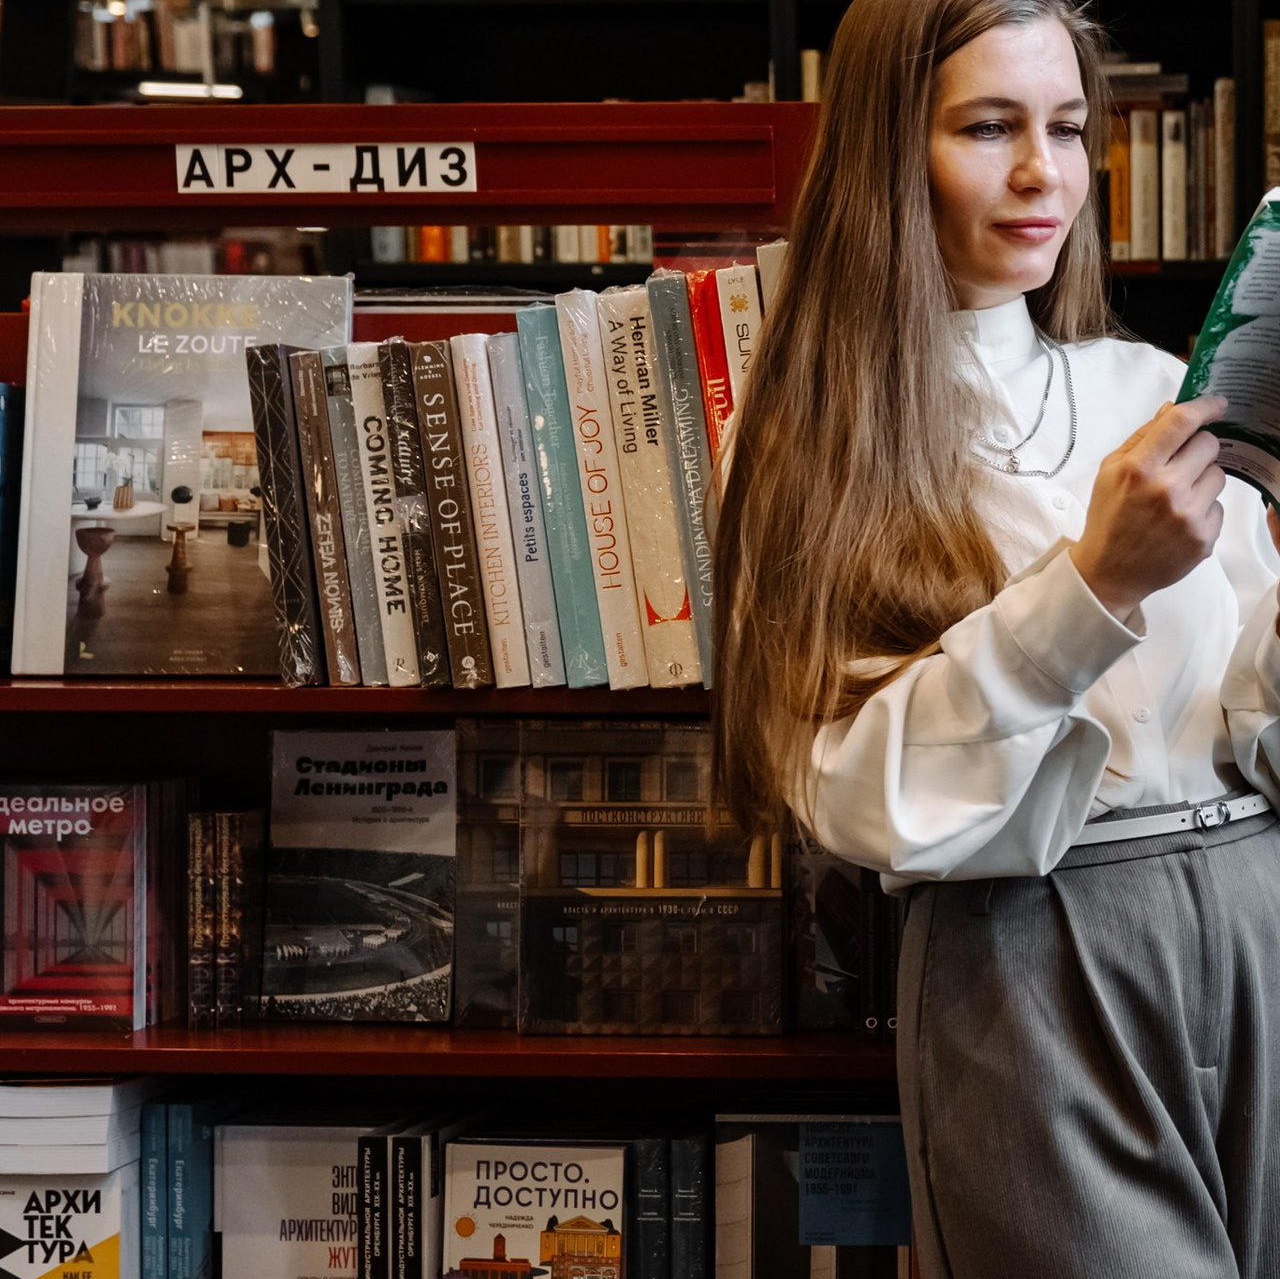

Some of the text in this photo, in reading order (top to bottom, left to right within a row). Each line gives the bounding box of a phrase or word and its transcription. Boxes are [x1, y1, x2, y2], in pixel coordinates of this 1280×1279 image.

[182, 146, 470, 192] АРХ-ДИЗ
[111, 301, 260, 329] KNOKKE
[138, 334, 258, 354] LE ZOUTE
[536, 334, 551, 388] Fashion
[608, 320, 638, 454] A Way of Living
[629, 315, 660, 447] Herman Miller
[576, 404, 623, 591] HOUSE OF JOY
[673, 387, 713, 607] SCANDINAVIA DREAMING
[363, 415, 407, 616] COMING HOME
[422, 392, 475, 638] SENSE OF PLACE
[519, 471, 539, 563] Petits espaces
[470, 441, 511, 627] KITCHEN INTERIORS
[314, 512, 343, 632] SIMÓN VÉLEZ
[501, 637, 511, 675] gestalten
[541, 629, 551, 669] gestalten
[617, 631, 628, 669] gestalten
[295, 756, 427, 776] Стадионы
[294, 778, 448, 801] Ленинграда
[581, 809, 722, 823] ПОСТКОНСТРУКТИВИ
[8, 818, 92, 843] метро
[716, 904, 740, 915] СССР
[804, 1137, 875, 1149] АРХИТЕКТУРА
[475, 1160, 590, 1184] ПРОСТО.
[804, 1152, 870, 1164] СОВЕТСКОГО
[804, 1168, 877, 1180] МОДЕРНИЗМА
[22, 1189, 102, 1215] АРХИ
[147, 1157, 160, 1230] Екатеринбург
[174, 1159, 186, 1231] Екатеринбург
[473, 1185, 619, 1211] ДОСТУПНО
[22, 1215, 73, 1240] ТЕК
[279, 1219, 358, 1242] АРХИТЕКТУР
[504, 1214, 534, 1222] НАДЕЖДА
[23, 1240, 95, 1265] ТУРА
